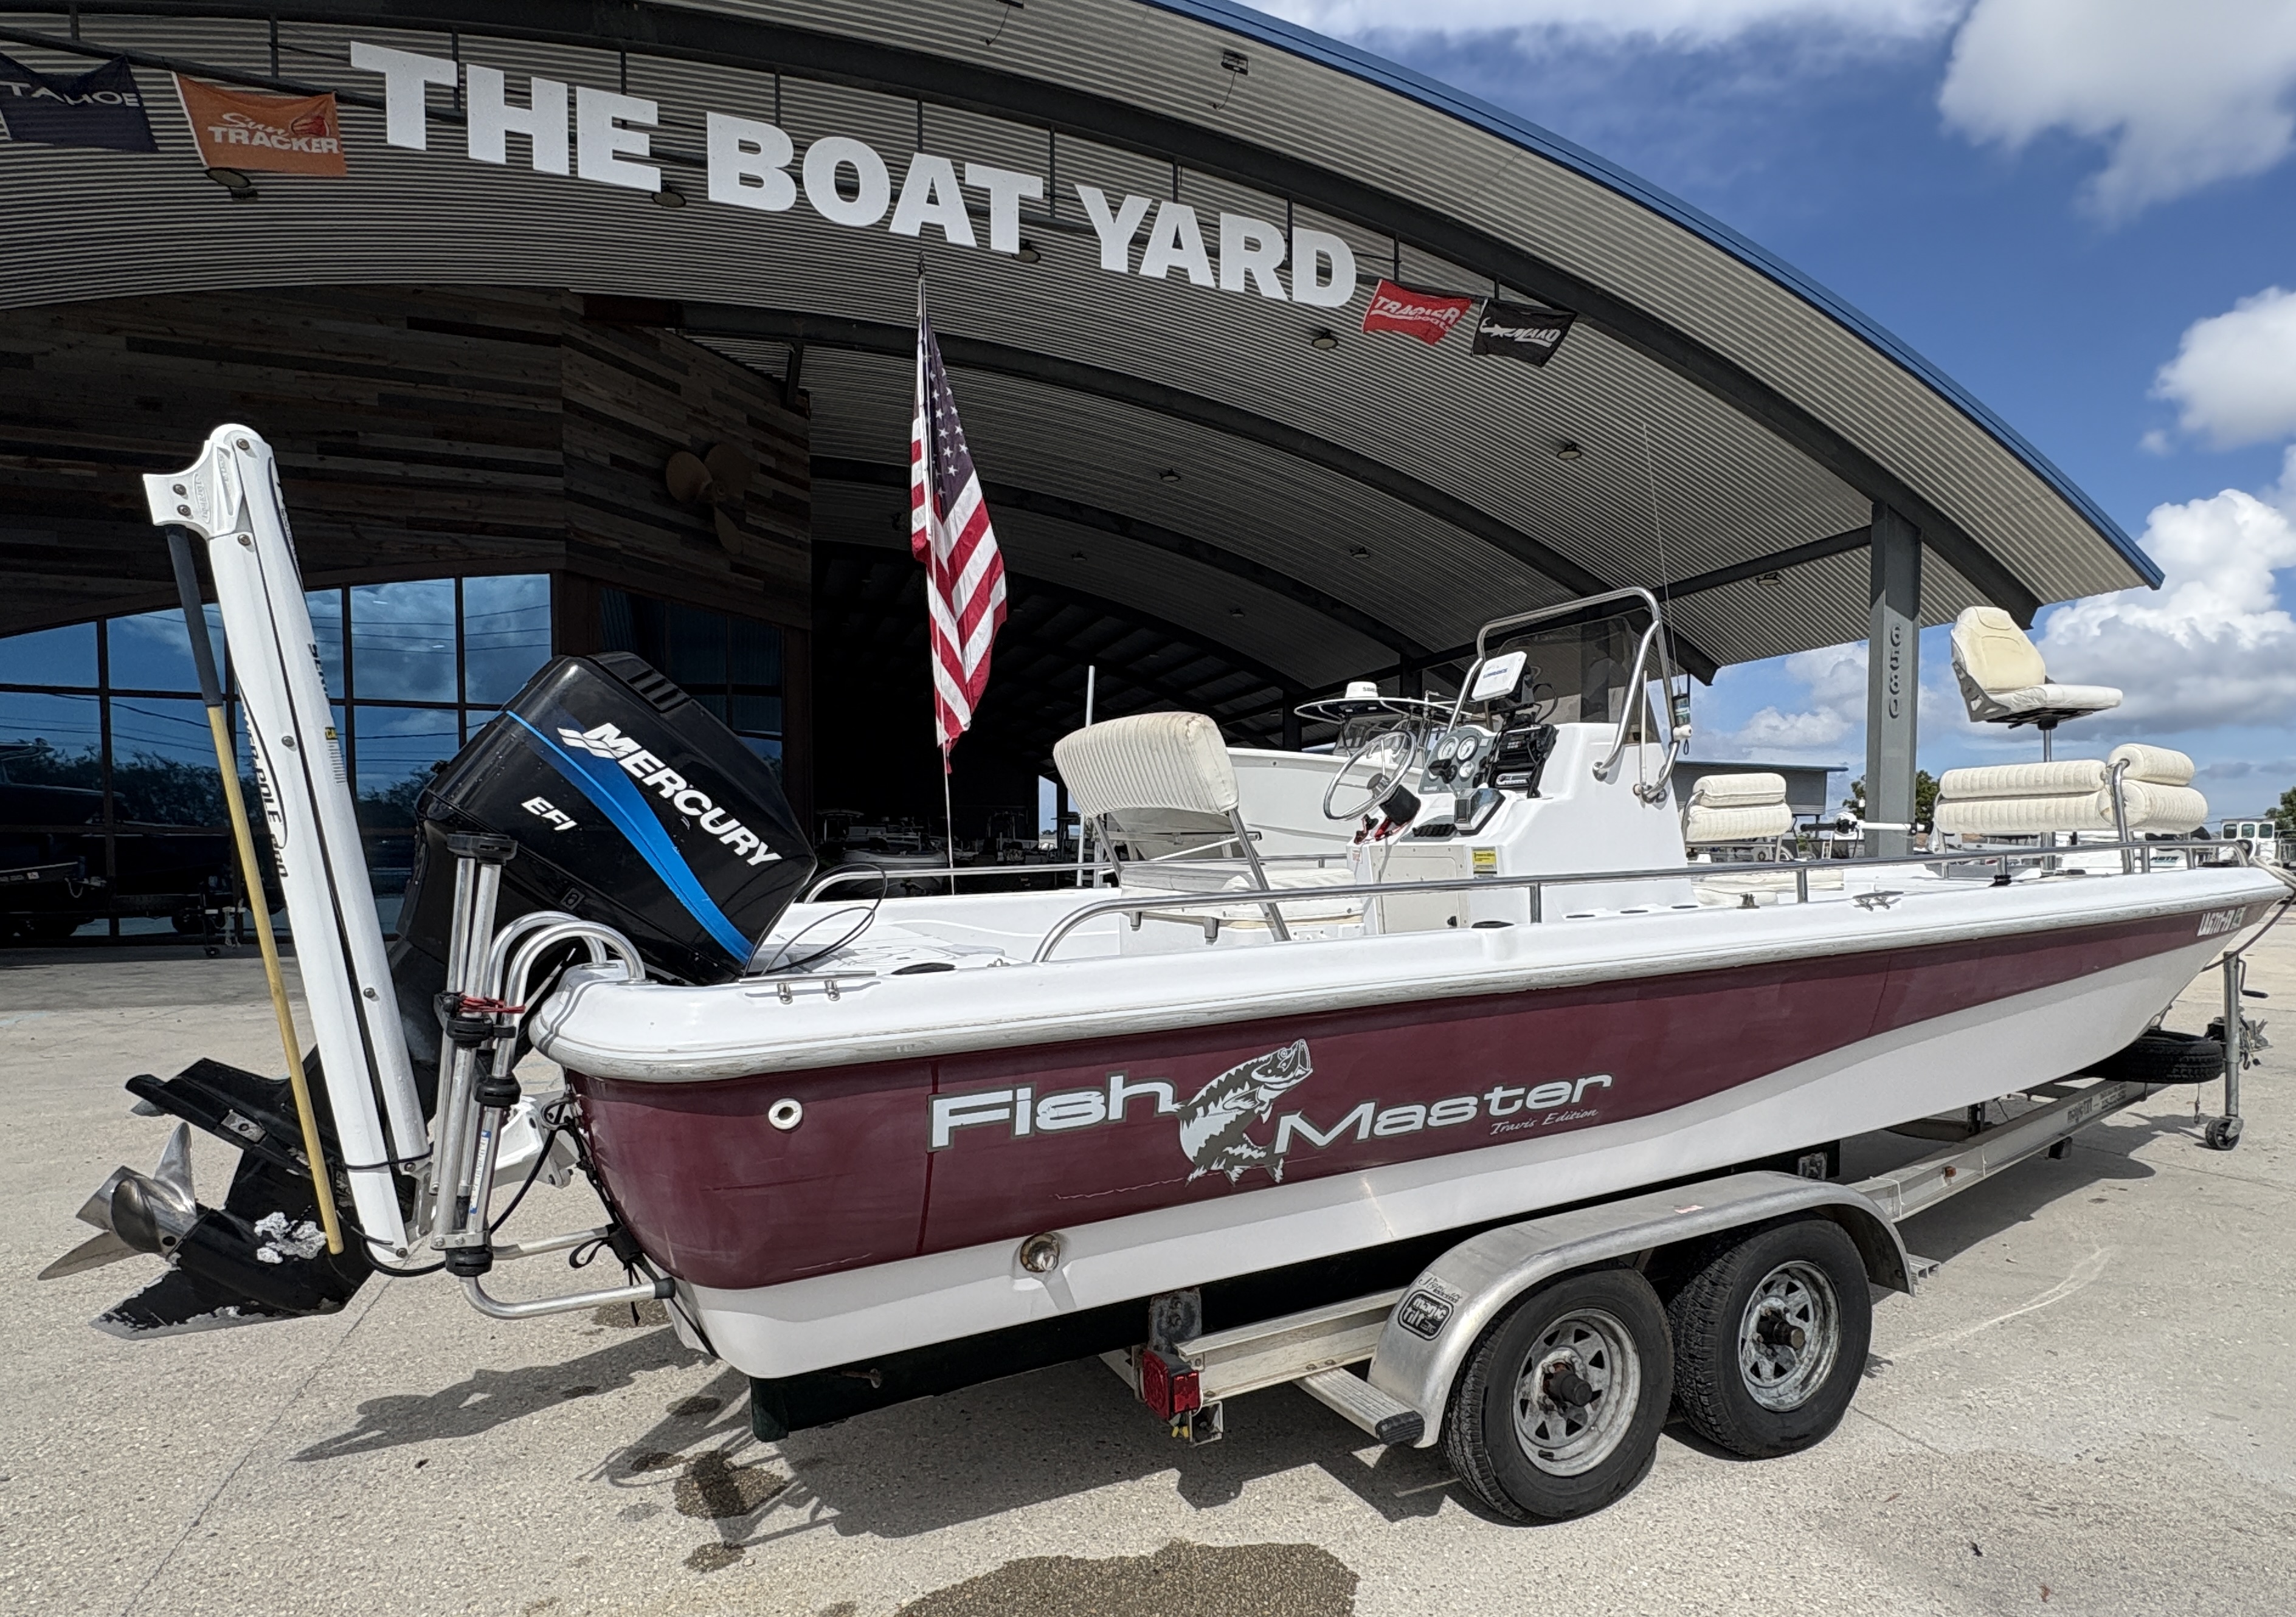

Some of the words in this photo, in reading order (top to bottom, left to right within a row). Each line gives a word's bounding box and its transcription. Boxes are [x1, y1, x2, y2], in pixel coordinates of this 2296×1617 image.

[0, 81, 140, 107] TAHOE
[221, 112, 289, 137] Sun
[207, 126, 340, 154] TRACKER
[351, 41, 661, 193] THE
[707, 112, 1043, 254] BOAT
[1074, 184, 1357, 308] YARD
[1889, 622, 1901, 719] 6580
[581, 722, 783, 867] MERCURY
[521, 796, 578, 832] EFI
[932, 1074, 1177, 1148] Fish
[1274, 1074, 1613, 1154] Master
[1490, 1117, 1538, 1136] Travis
[1541, 1108, 1599, 1126] Edition
[1403, 1306, 1425, 1328] tilt
[1412, 1297, 1447, 1320] magic
